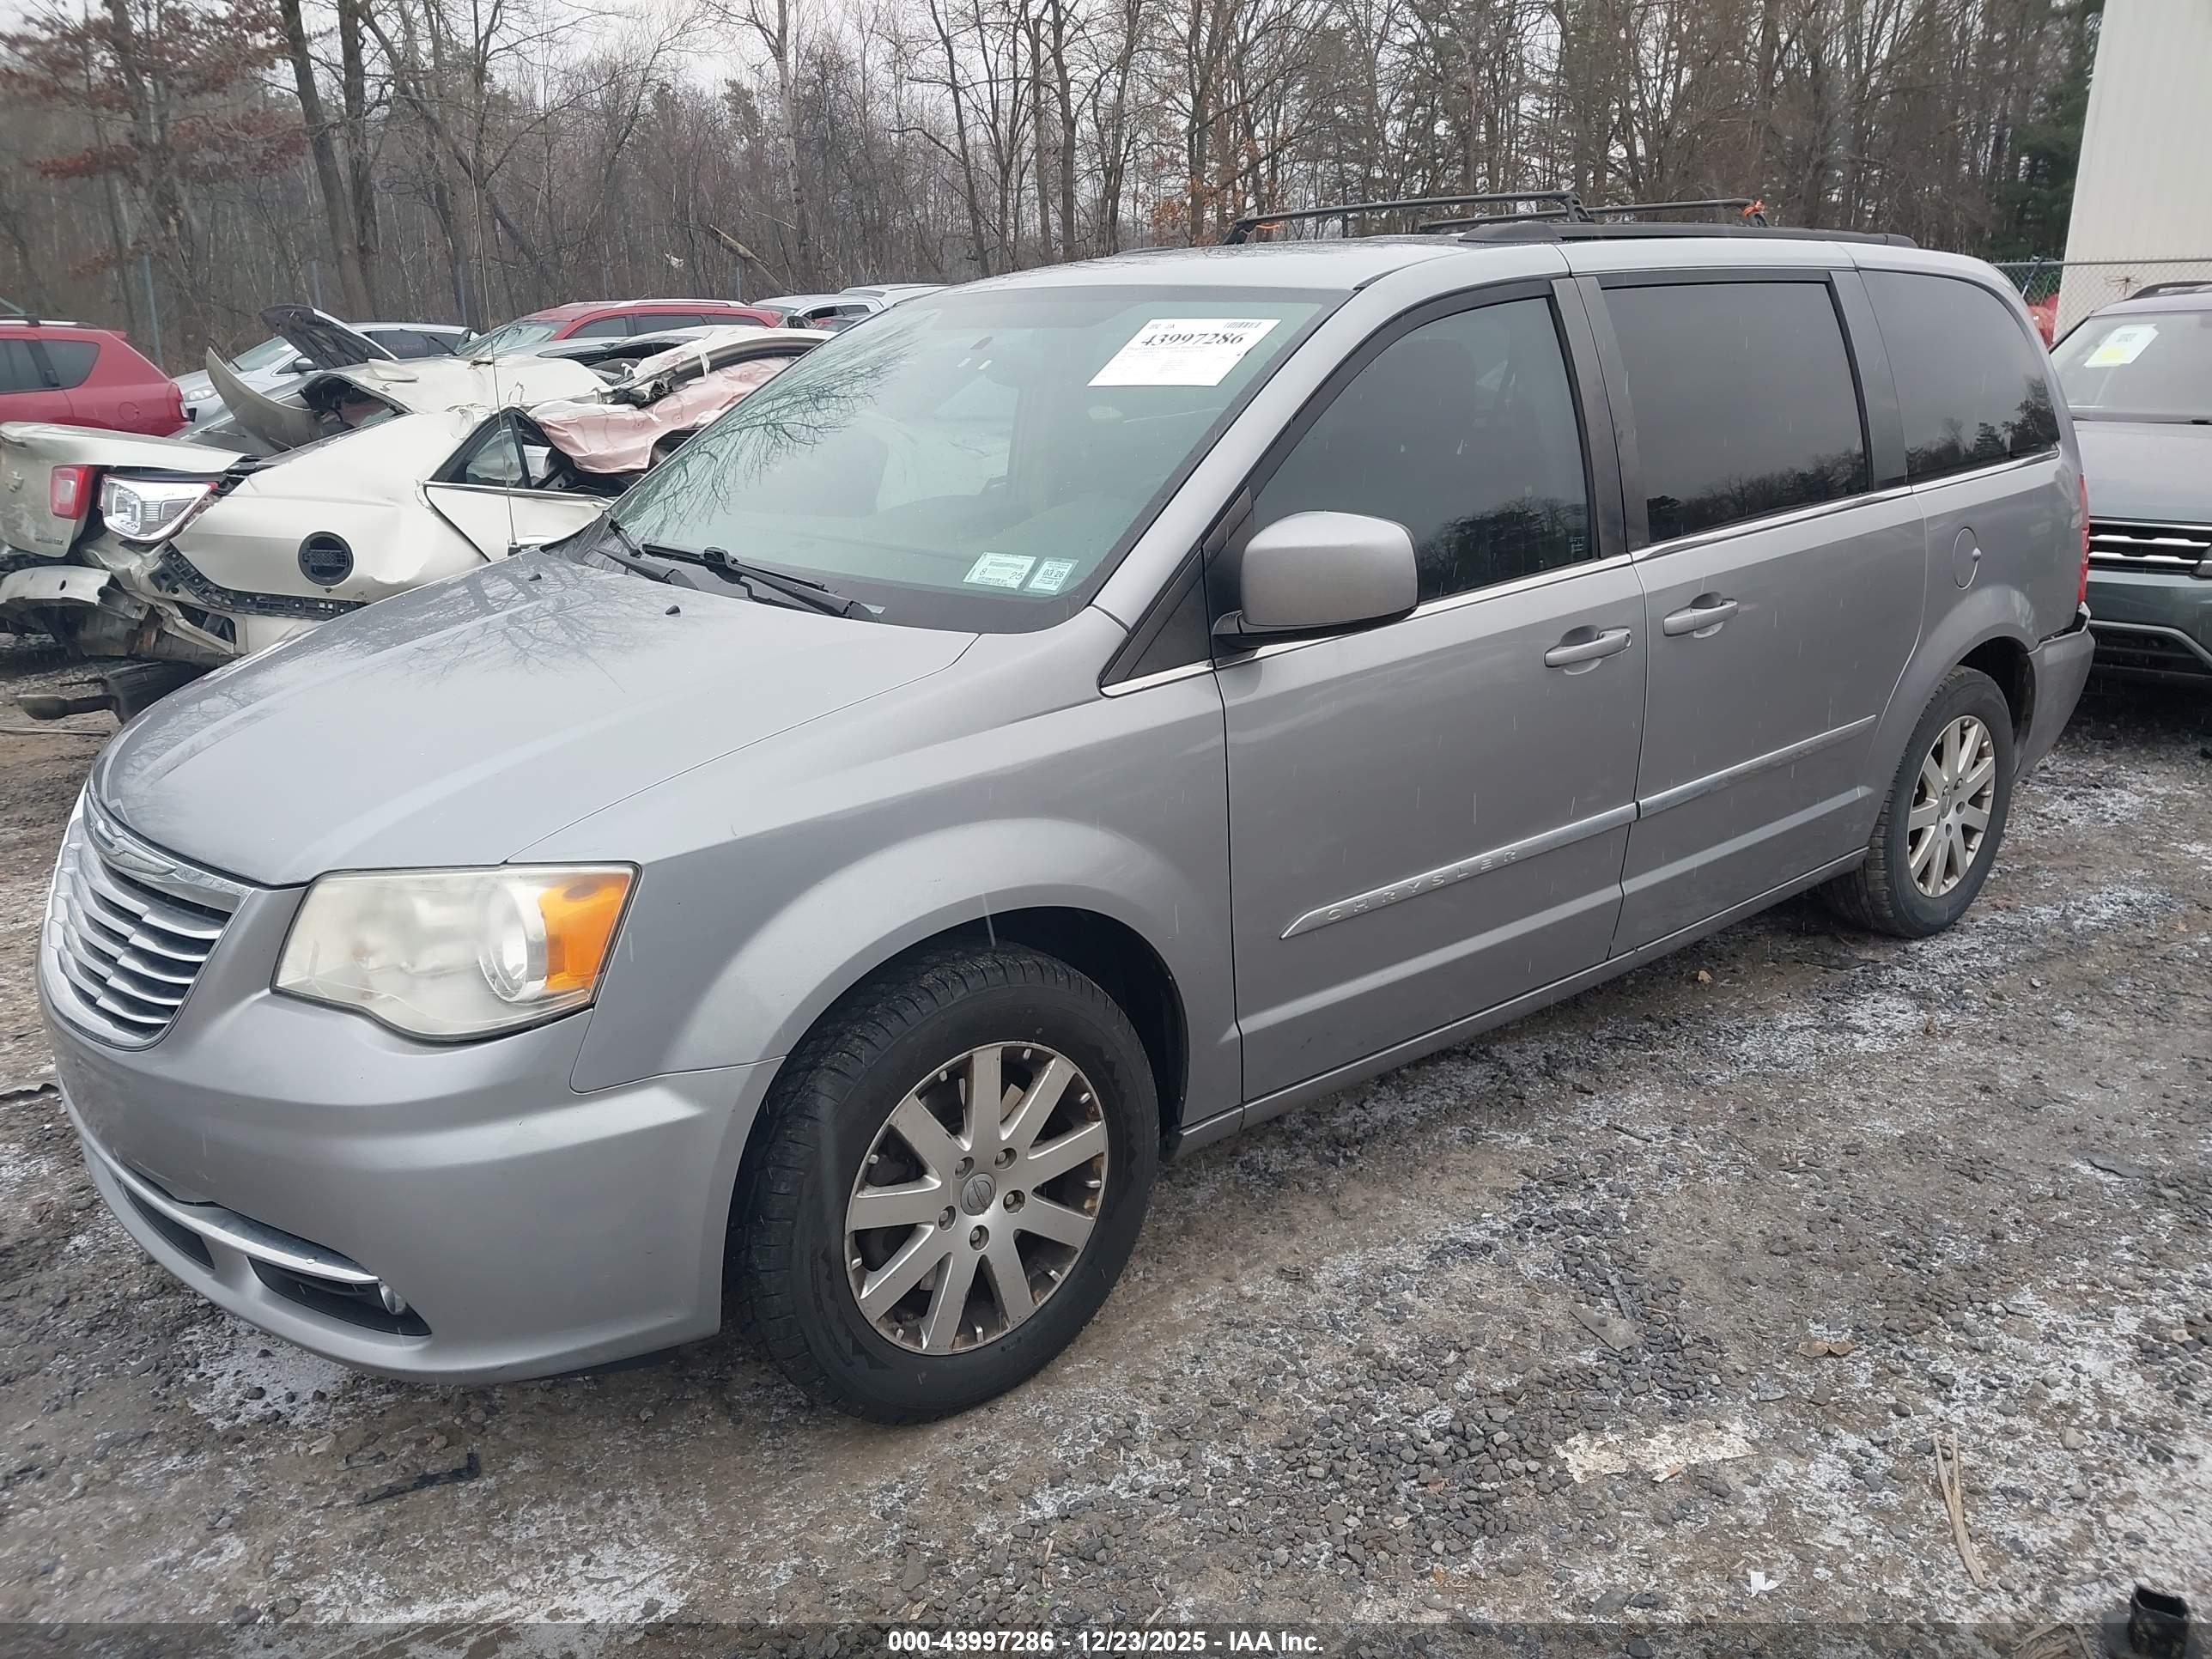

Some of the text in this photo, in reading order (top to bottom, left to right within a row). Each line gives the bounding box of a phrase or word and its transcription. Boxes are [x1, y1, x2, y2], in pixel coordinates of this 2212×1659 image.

[1141, 331, 1247, 347] 43997286
[1009, 571, 1024, 580] 25
[1327, 850, 1517, 921] CHRYSLER
